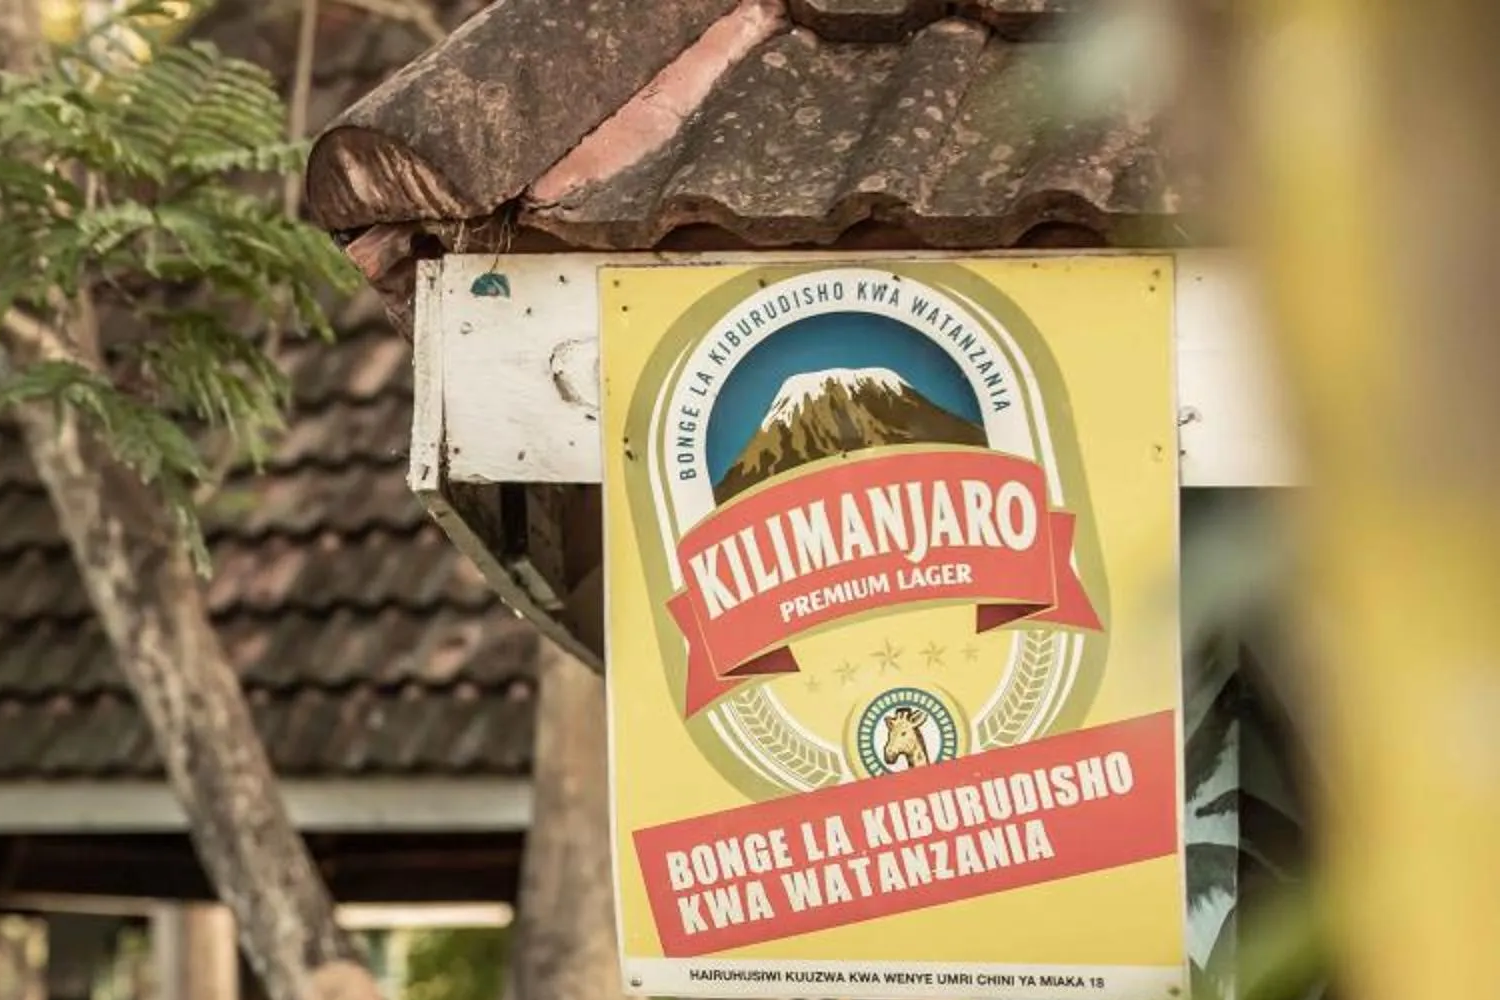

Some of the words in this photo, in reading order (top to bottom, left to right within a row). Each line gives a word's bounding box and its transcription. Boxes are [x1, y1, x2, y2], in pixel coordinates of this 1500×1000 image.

[677, 405, 700, 481] BONGE
[690, 371, 714, 397] LA
[708, 282, 843, 366] KIBURUDISHO
[857, 281, 901, 307] KWA
[911, 296, 1012, 412] WATANZANIA
[688, 480, 1037, 620] KILIMANJARO
[780, 569, 890, 623] PREMIUM
[898, 563, 974, 590] LAGER
[666, 828, 794, 891] BONGE
[801, 815, 854, 861] LA
[861, 751, 1134, 848] KIBURUDISHO
[677, 880, 775, 935] KWA
[780, 819, 1055, 912] WATANZANIA
[690, 969, 781, 982] HAIRUHUSIWI
[785, 971, 846, 983] KUUZWA
[850, 972, 881, 984] KWA
[883, 973, 933, 985] WENYE
[937, 974, 973, 985] UMRI
[977, 974, 1015, 986] CHINI
[1019, 975, 1036, 986] YA
[1040, 976, 1085, 988] MIAKA
[1090, 978, 1105, 988] 18
